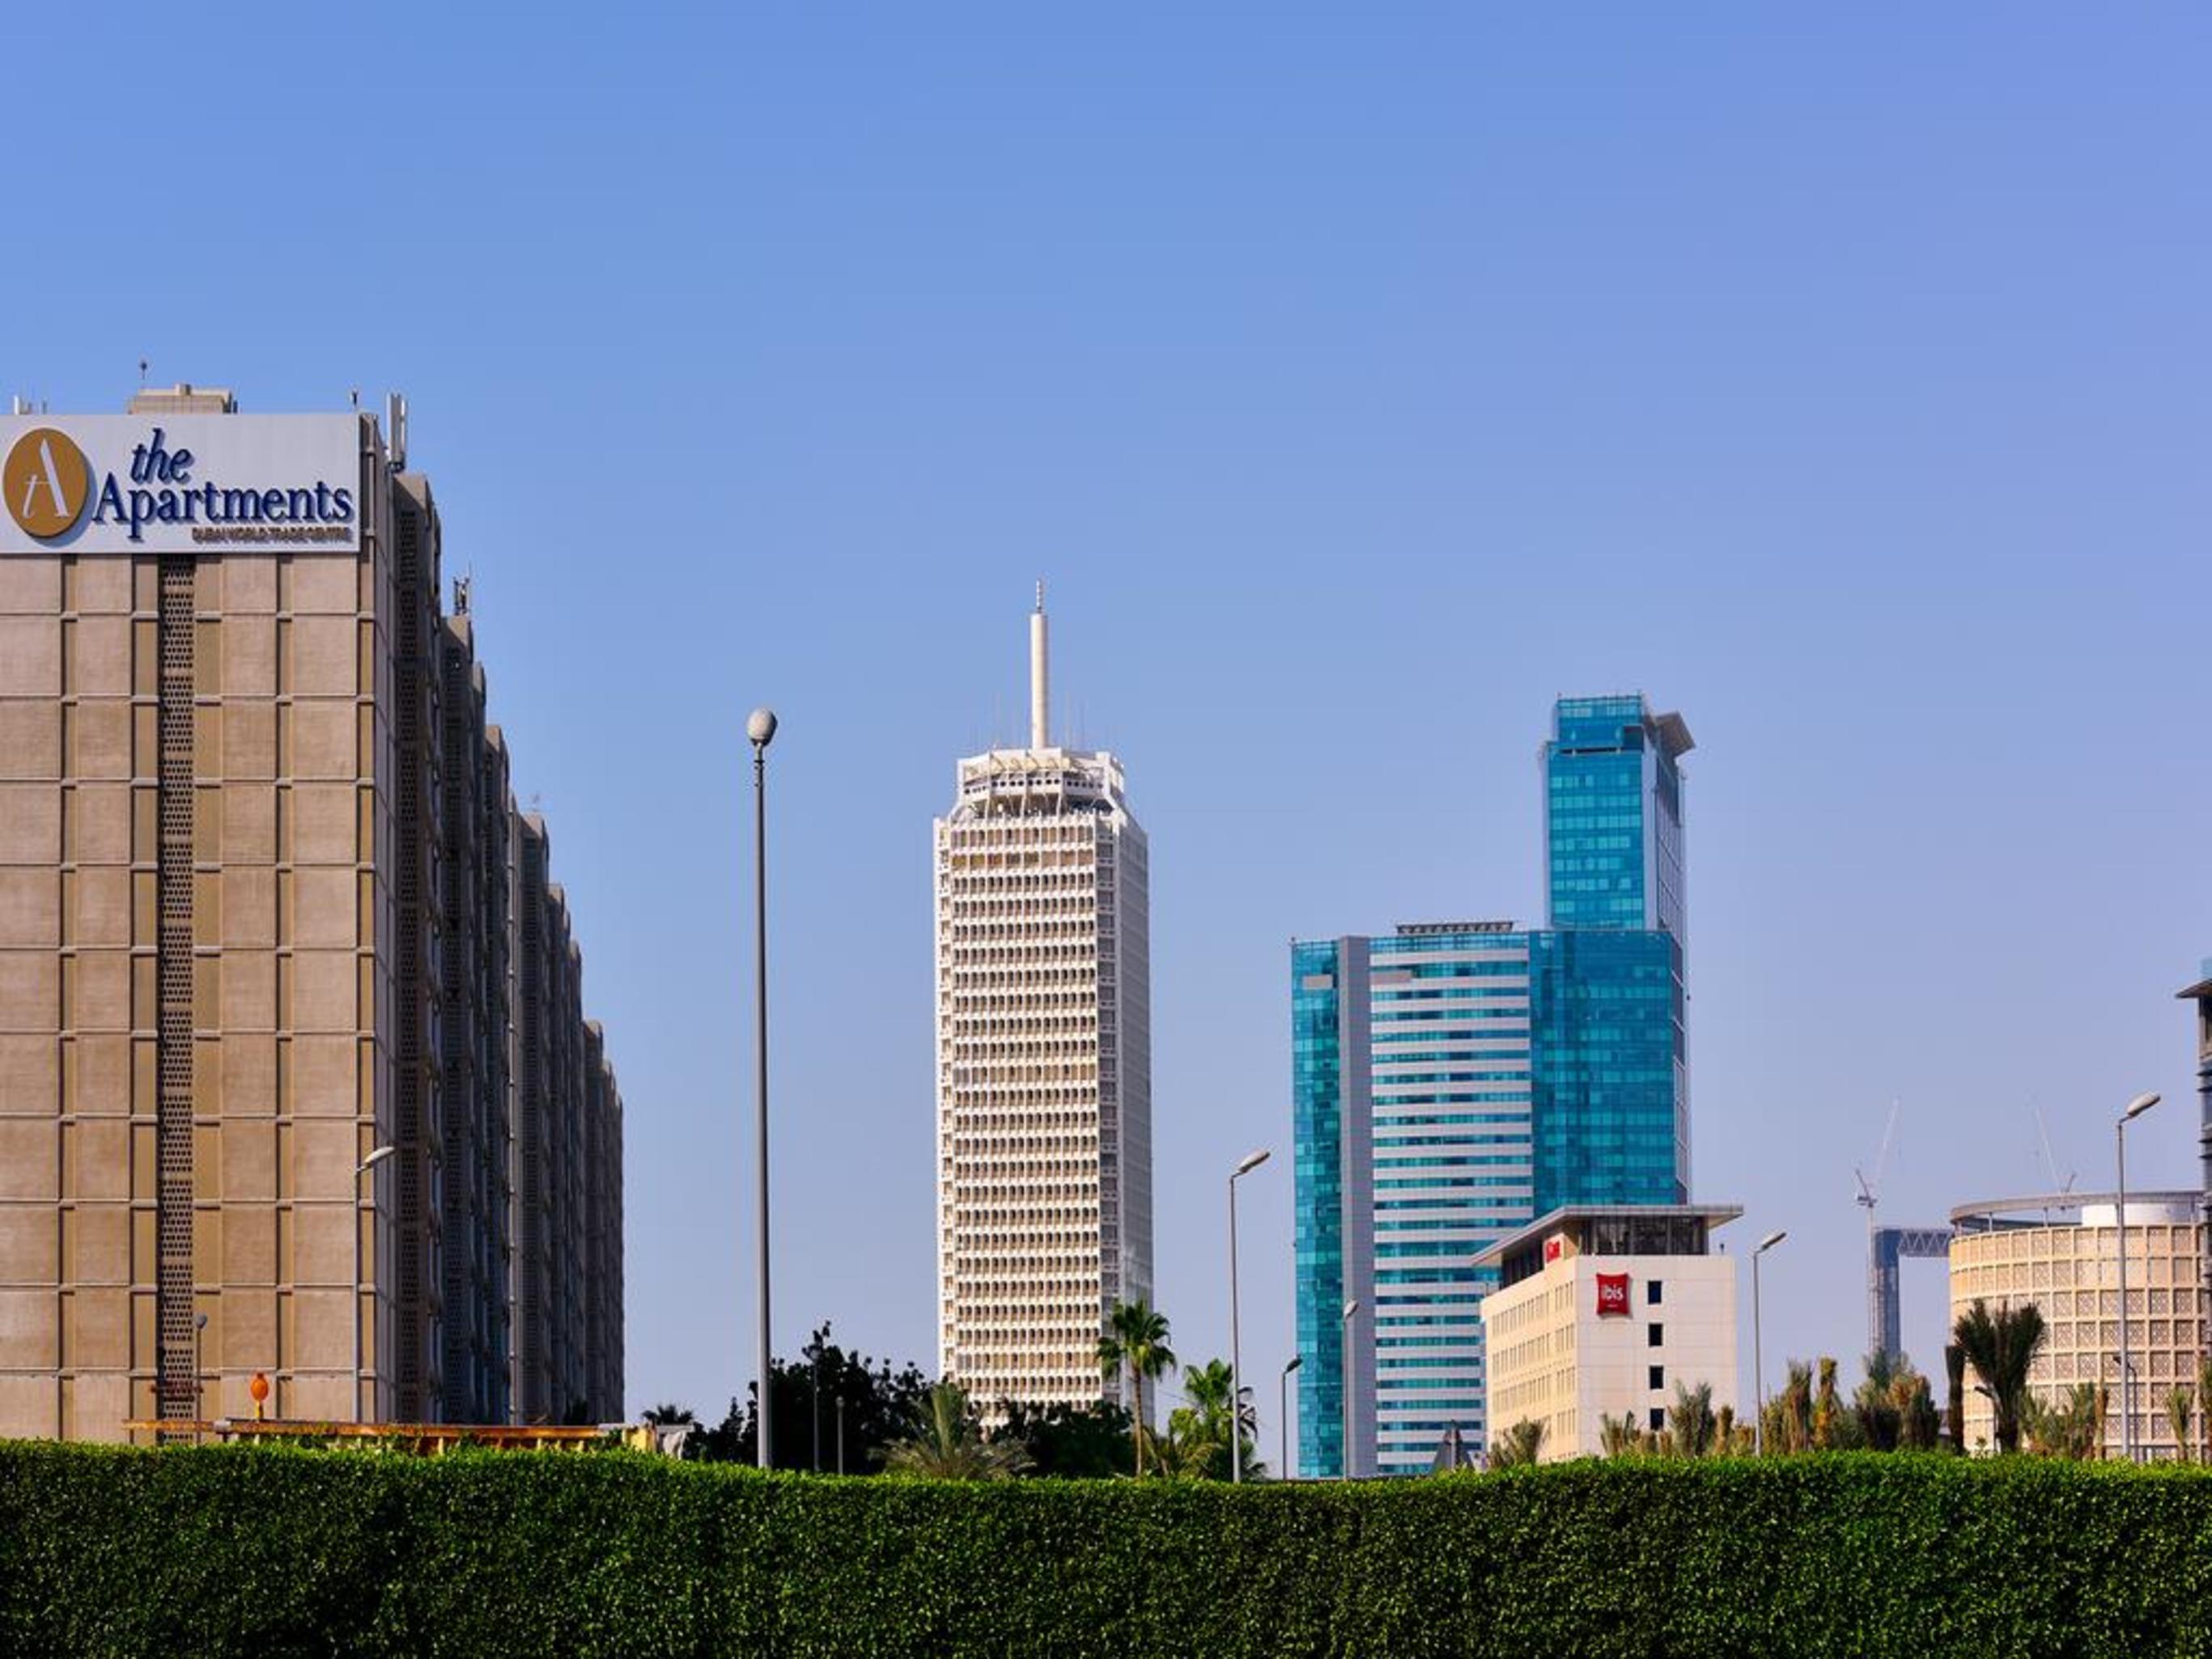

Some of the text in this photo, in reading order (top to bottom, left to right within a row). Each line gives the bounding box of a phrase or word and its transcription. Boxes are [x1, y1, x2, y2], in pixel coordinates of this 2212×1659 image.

[130, 427, 192, 482] the
[91, 472, 351, 541] Apartments
[1600, 1284, 1624, 1301] ibis
